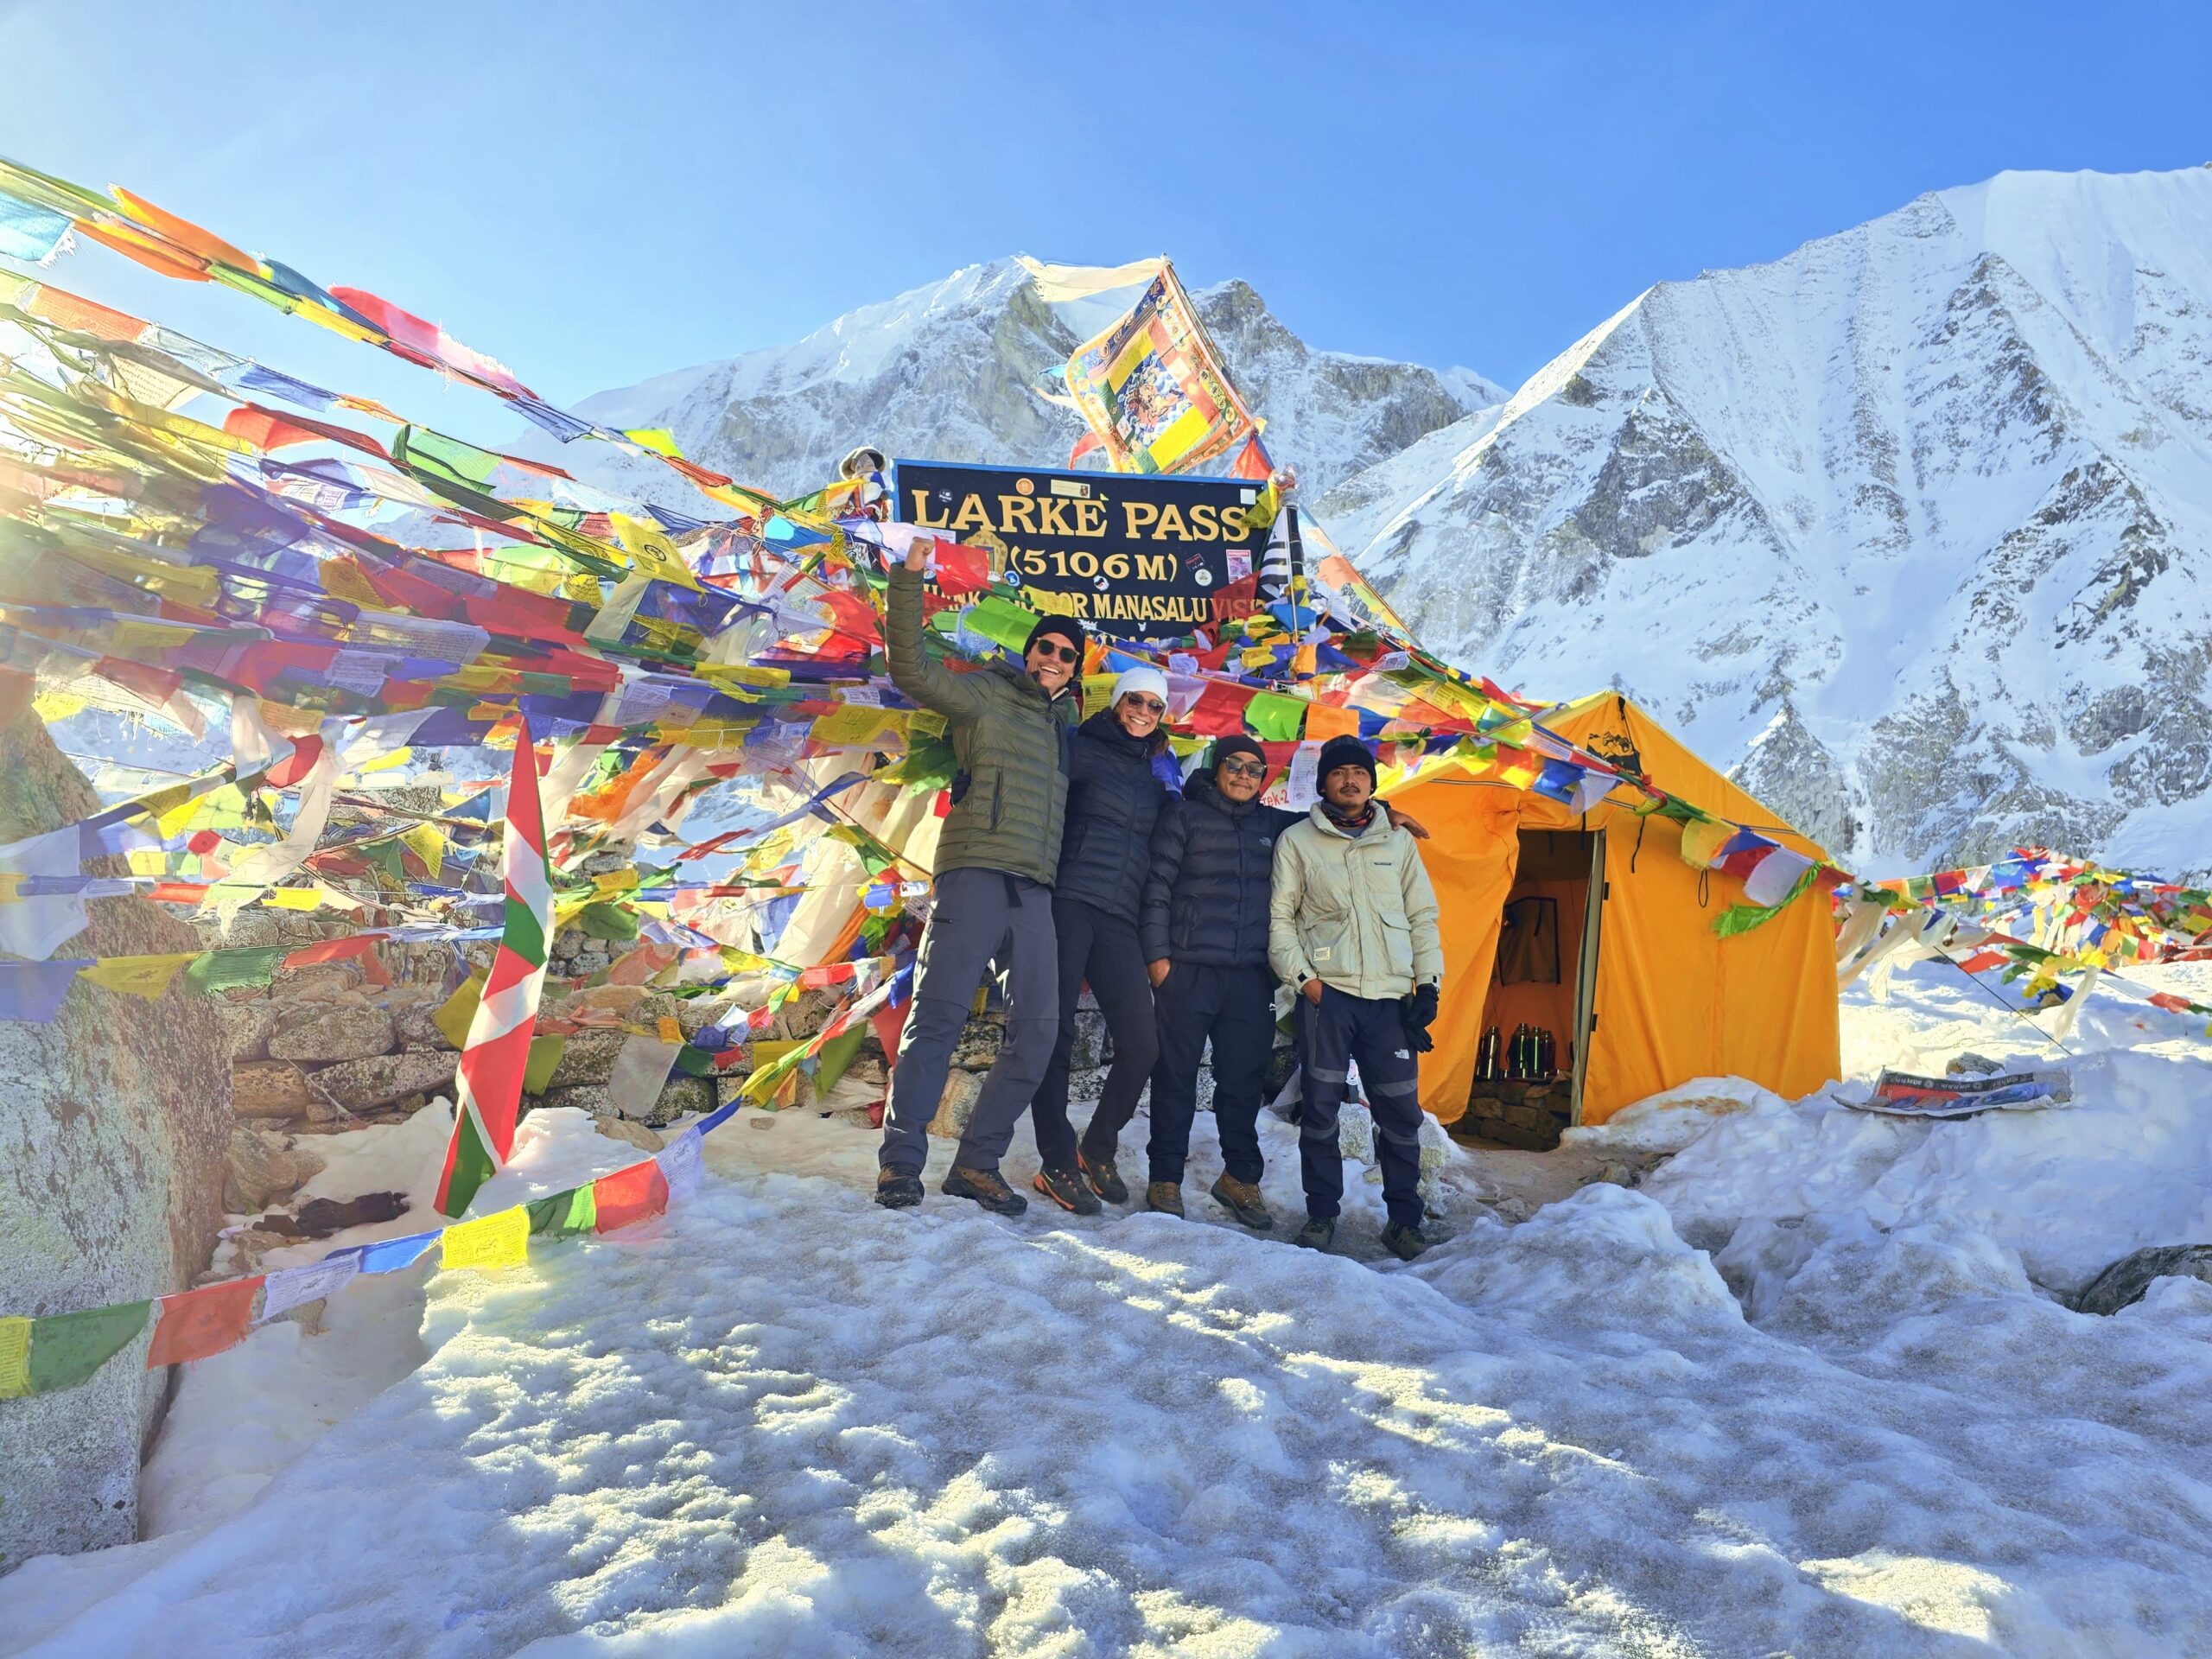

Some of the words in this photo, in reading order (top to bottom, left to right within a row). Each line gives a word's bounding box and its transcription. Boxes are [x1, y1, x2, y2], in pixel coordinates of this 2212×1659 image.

[1122, 502, 1250, 543] PASS
[1092, 593, 1207, 622] MANASALU
[1210, 597, 1268, 622] VISI
